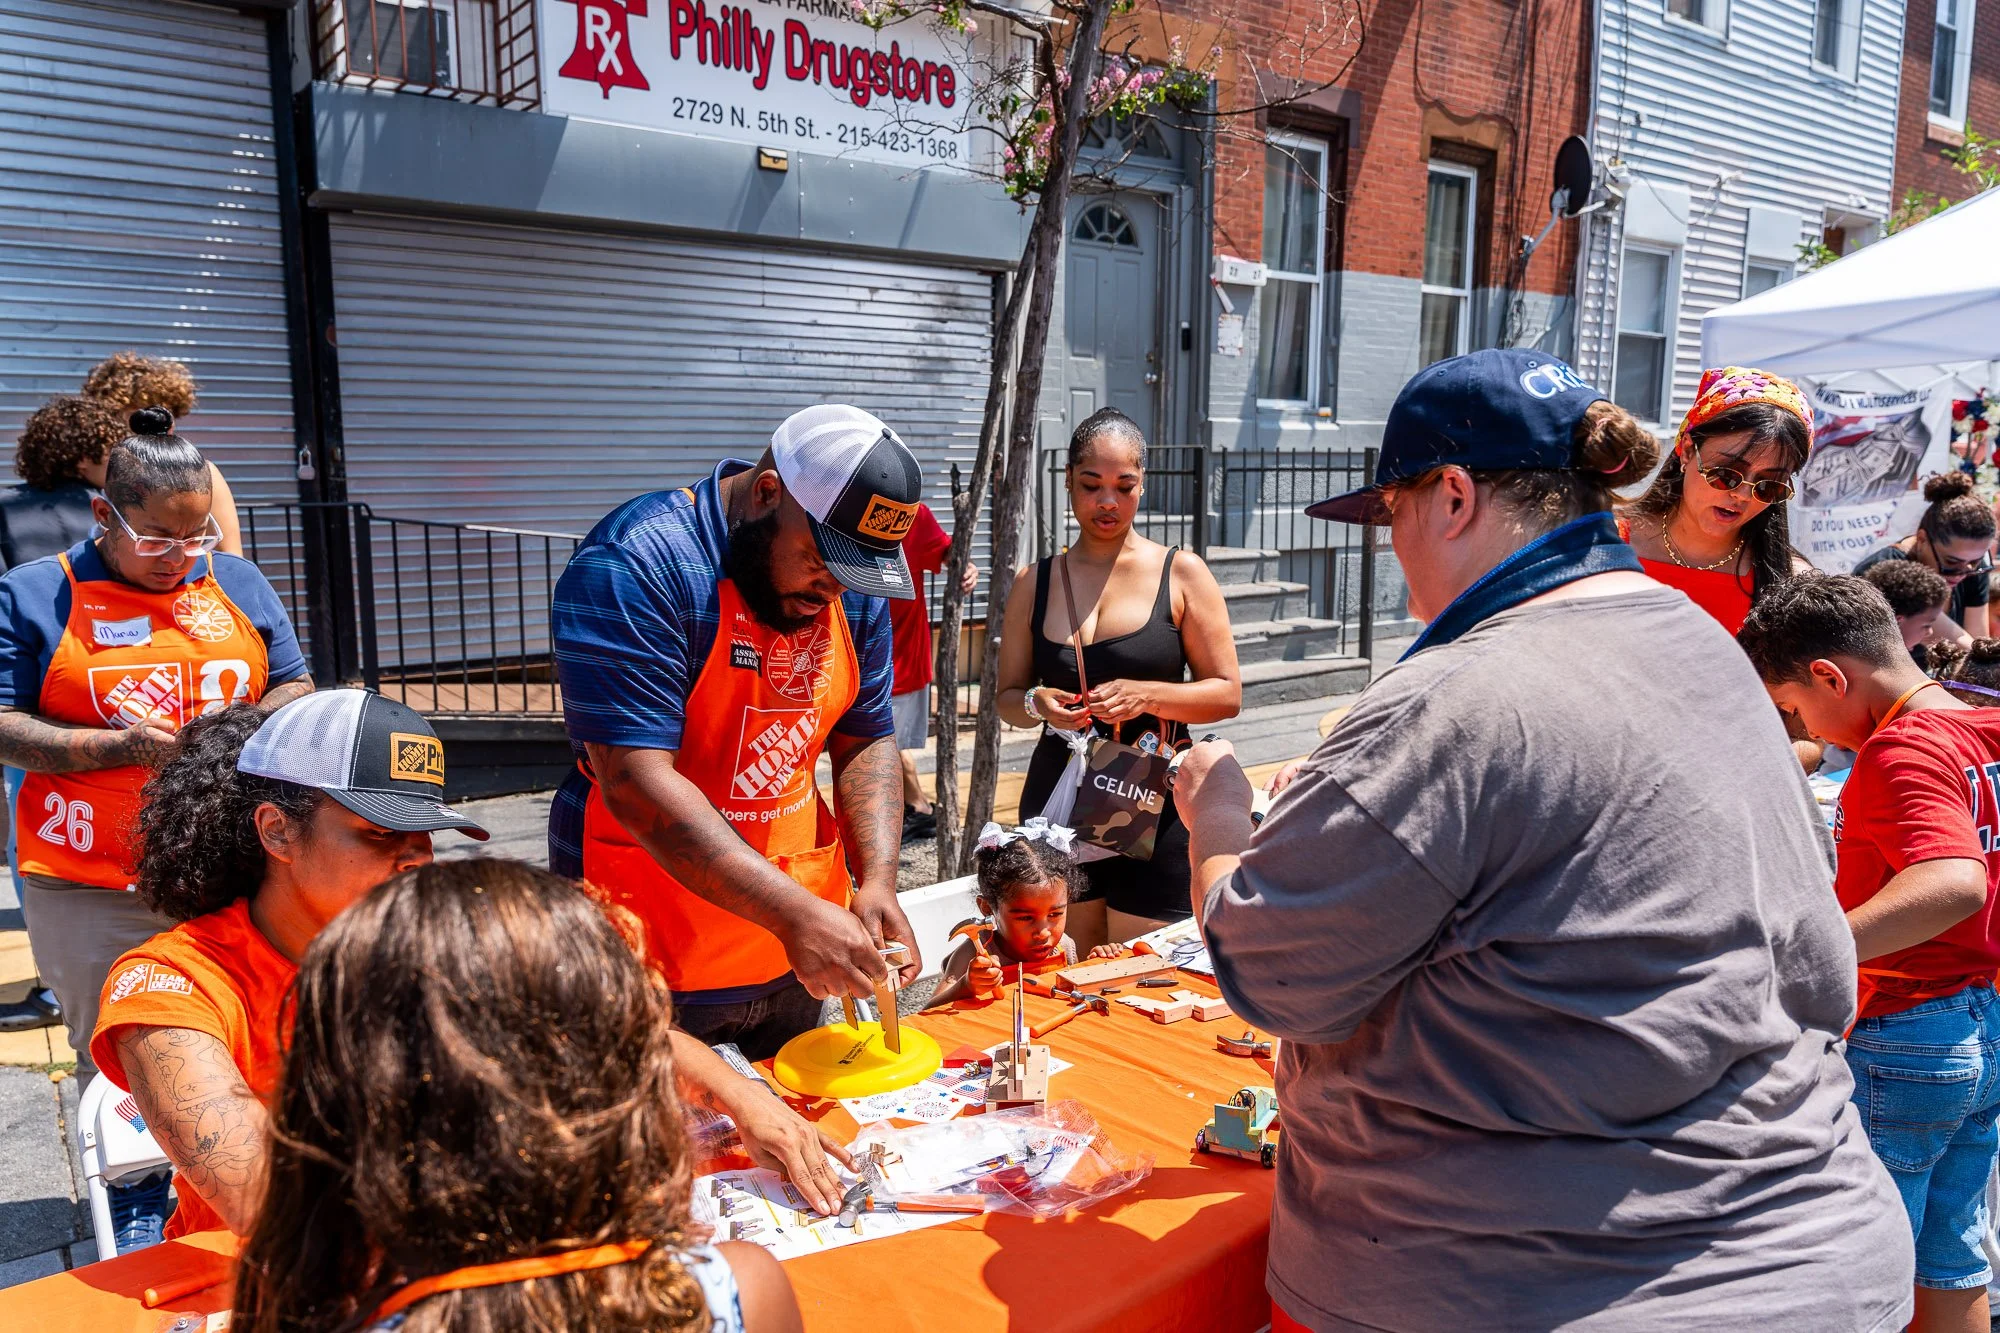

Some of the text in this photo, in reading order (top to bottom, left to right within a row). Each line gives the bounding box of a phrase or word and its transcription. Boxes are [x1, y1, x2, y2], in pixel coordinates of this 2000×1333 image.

[669, 0, 956, 108] Philly Drugstore
[672, 97, 723, 124] 2729
[731, 106, 751, 129] N.
[758, 111, 788, 135] 5th
[794, 116, 820, 140] St.
[838, 124, 958, 160] 215-423-1368
[1825, 519, 1844, 532] YOU
[1847, 515, 1881, 529] NEED
[1811, 535, 1874, 553] WITH YOUR
[103, 674, 140, 708] THE
[735, 709, 820, 799] HOME
[748, 719, 788, 757] THE
[1093, 774, 1158, 806] CELINE
[36, 791, 94, 853] 26
[721, 807, 758, 822] oers
[760, 807, 781, 824] get
[152, 980, 188, 991] DEPOT
[153, 973, 187, 984] TEAM
